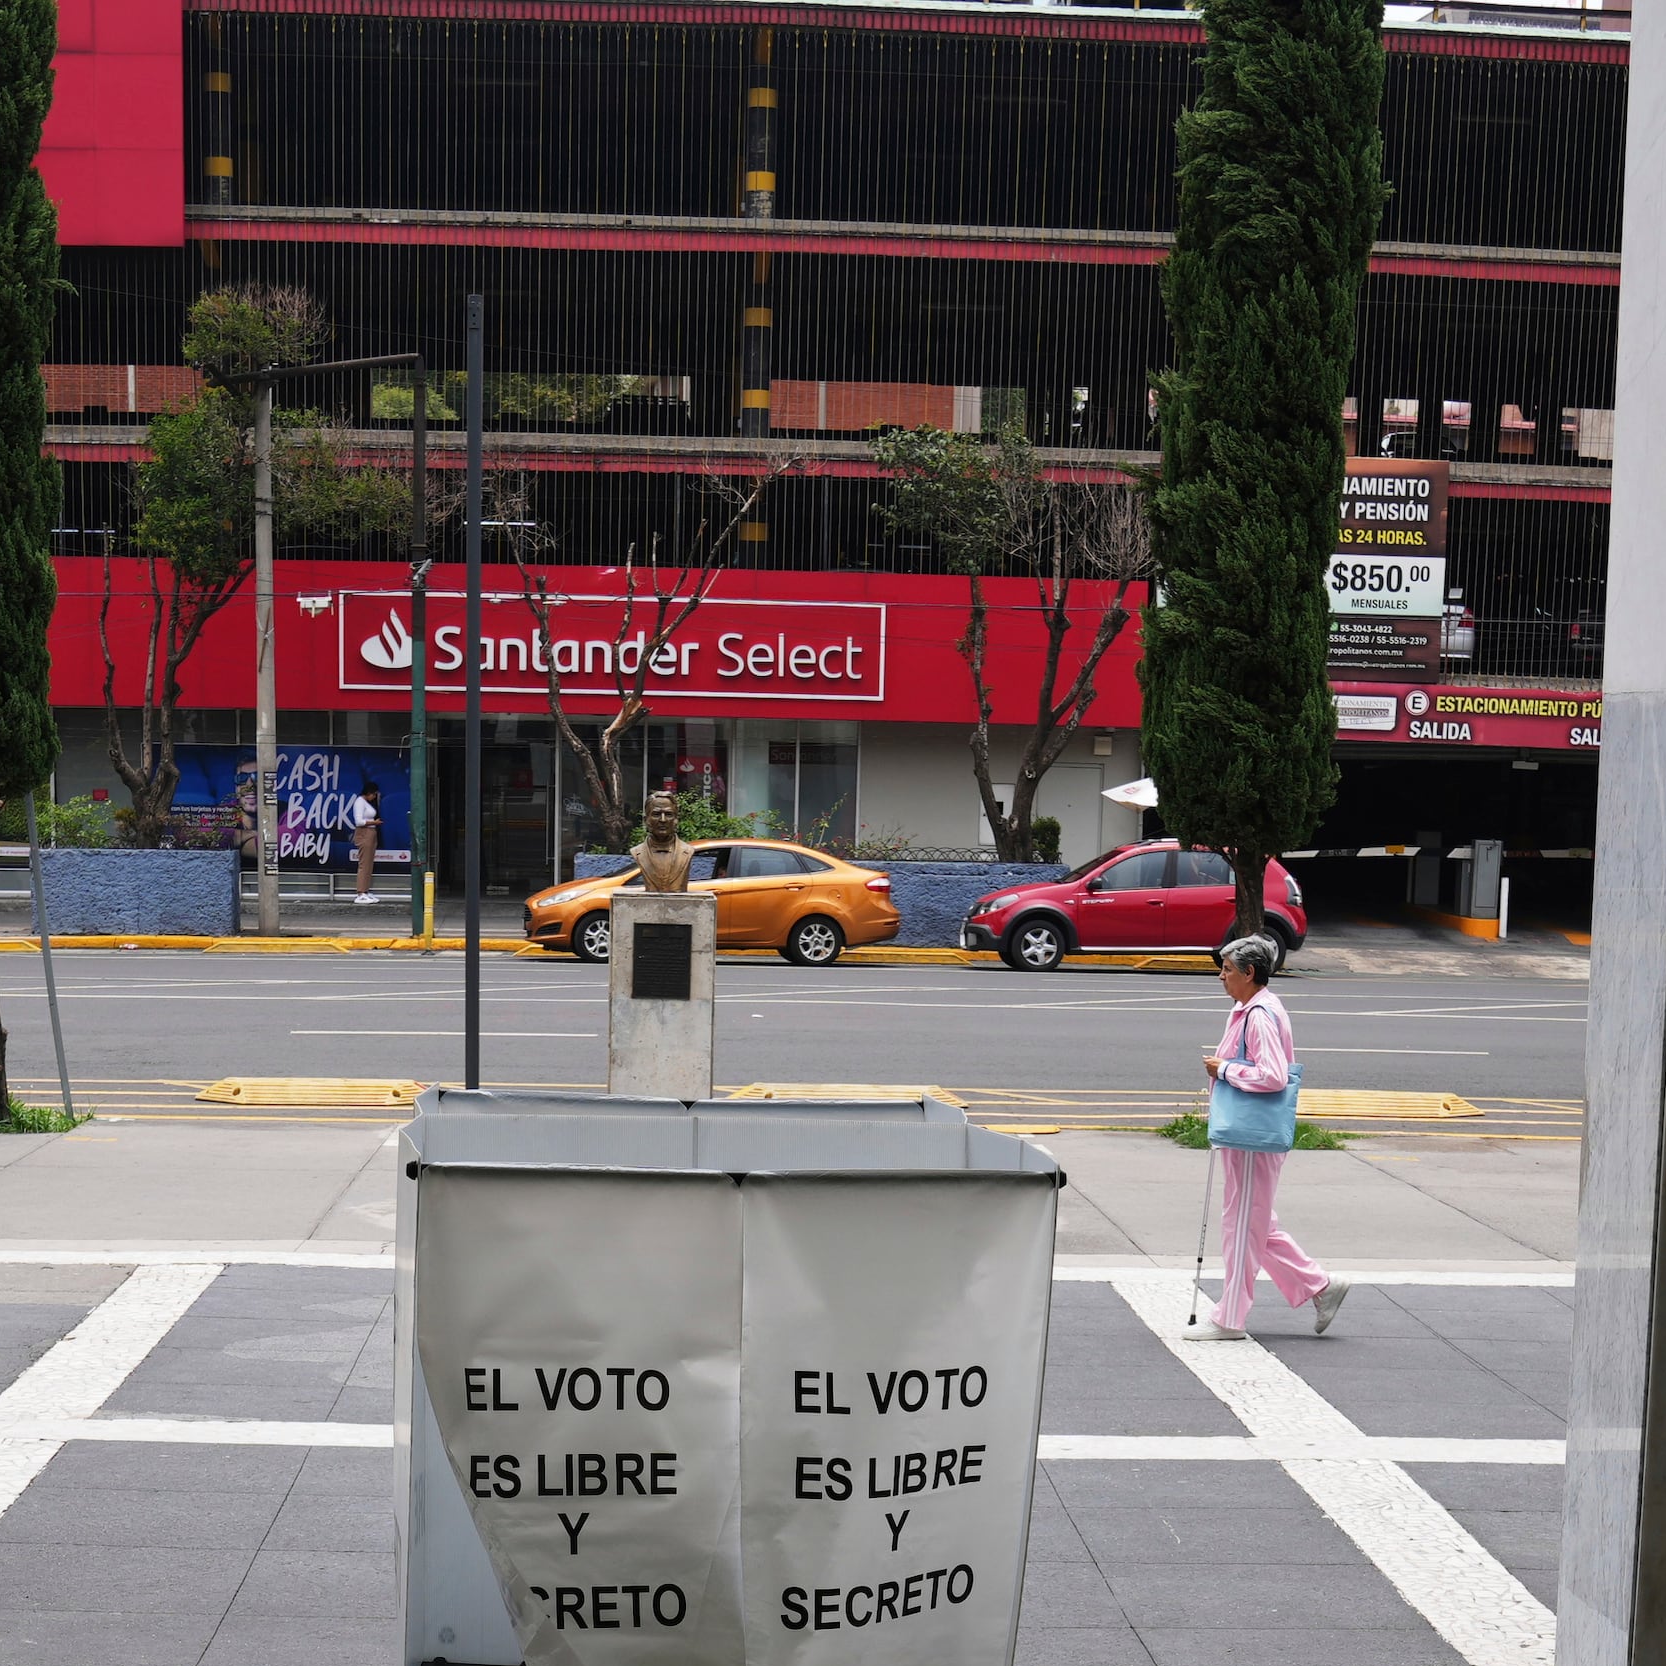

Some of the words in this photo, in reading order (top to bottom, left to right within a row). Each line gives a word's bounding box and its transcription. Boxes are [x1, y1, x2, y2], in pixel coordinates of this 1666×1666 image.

[1354, 500, 1429, 522] PENSIÓN
[1356, 529, 1374, 544] 24
[1377, 530, 1427, 546] HORAS.
[1351, 598, 1408, 610] MENSUALES
[434, 625, 700, 676] Santander
[717, 632, 864, 681] Select
[1436, 696, 1579, 718] ESTACIONAMIENTO
[1409, 721, 1472, 741] SALIDA
[273, 753, 340, 793] CASH
[703, 763, 712, 803] TICO
[286, 792, 358, 831] BACK
[279, 832, 331, 865] BABY
[464, 1367, 520, 1412] EL
[534, 1367, 671, 1412] VOTO
[794, 1370, 852, 1415] EL
[866, 1365, 989, 1416] VOTO
[469, 1454, 522, 1499] ES
[536, 1453, 678, 1497] LIBRE
[795, 1456, 853, 1502] ES
[868, 1444, 987, 1499] LIBRE
[557, 1512, 590, 1556] Y
[885, 1510, 911, 1552] Y
[780, 1563, 975, 1631] SECRETO
